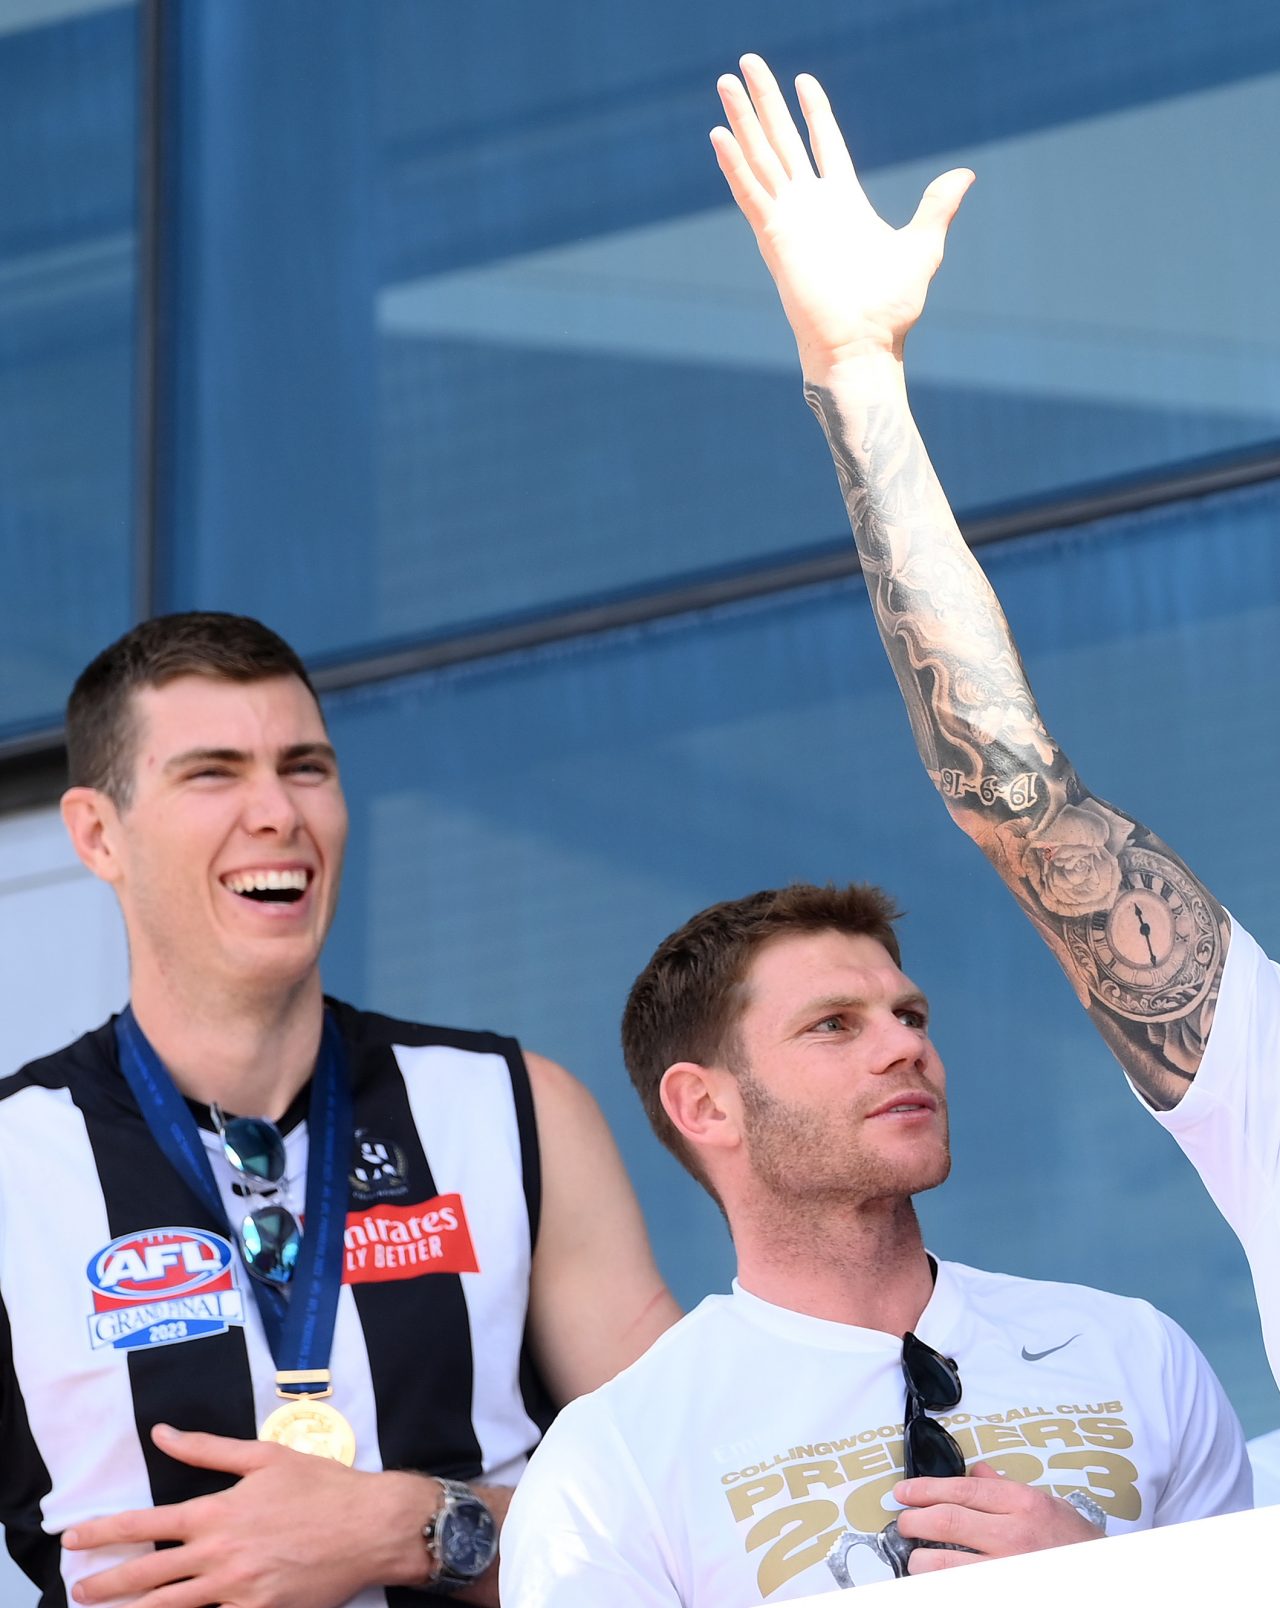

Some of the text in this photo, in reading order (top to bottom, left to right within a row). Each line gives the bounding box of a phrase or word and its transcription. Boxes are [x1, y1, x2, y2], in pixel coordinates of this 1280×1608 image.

[344, 1207, 459, 1250] mirates
[99, 1240, 223, 1288] AFL
[345, 1234, 444, 1272] LY BETTER
[149, 1319, 188, 1343] 2023
[1056, 1400, 1124, 1415] CLUB
[725, 1417, 1134, 1523] PREIERS
